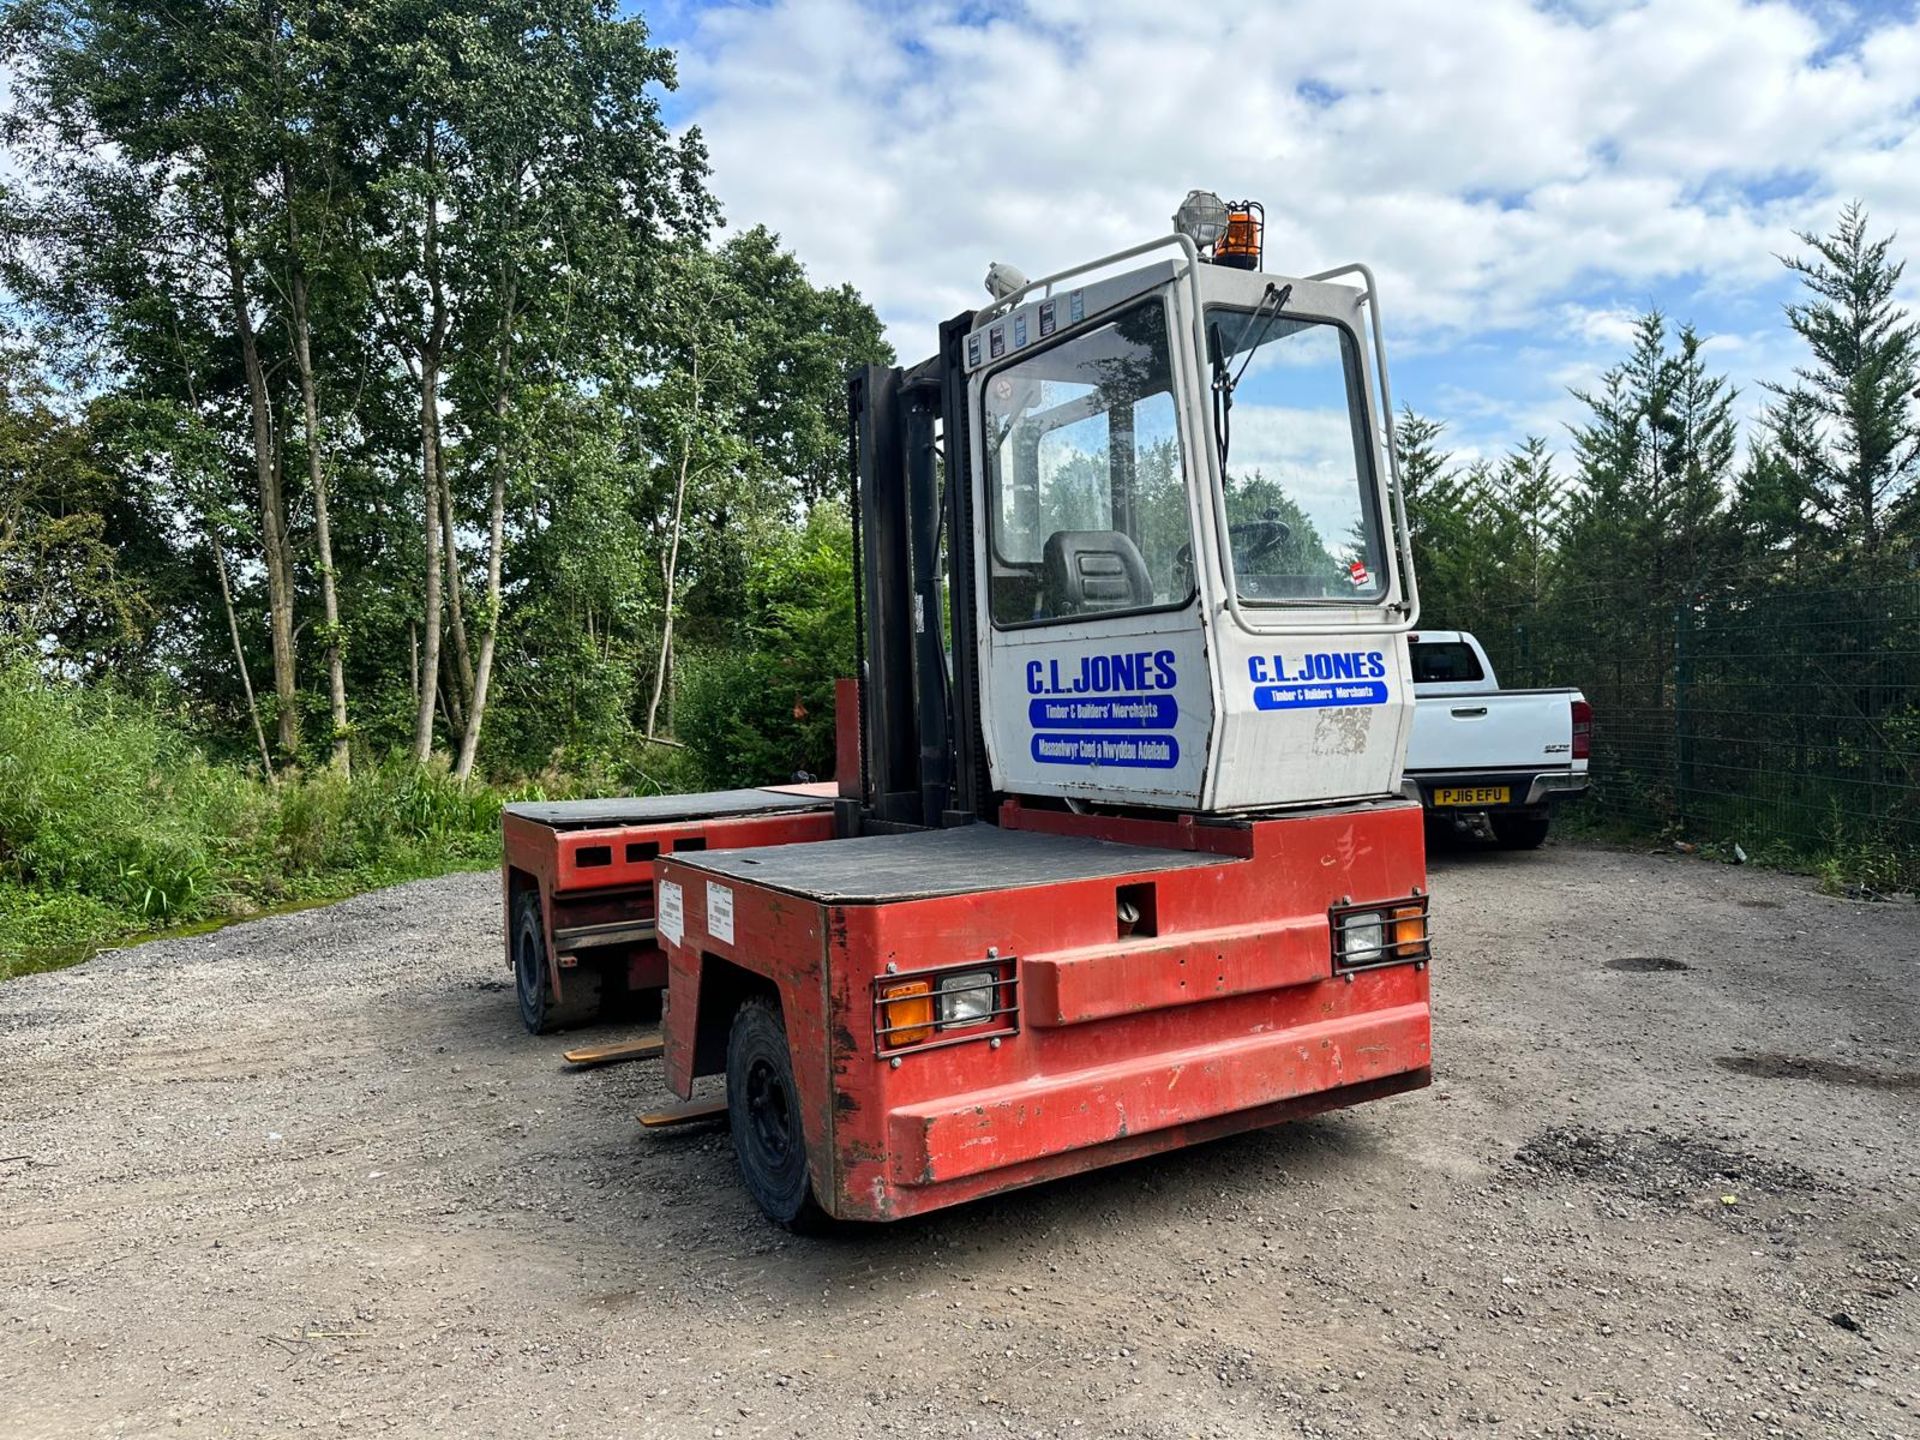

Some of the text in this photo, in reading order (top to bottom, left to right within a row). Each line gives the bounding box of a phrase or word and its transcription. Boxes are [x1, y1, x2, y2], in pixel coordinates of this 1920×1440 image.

[1026, 650, 1177, 694] C.L.JONES
[1248, 651, 1386, 683] C.L.JONES
[1272, 691, 1296, 701] Timber
[1336, 687, 1373, 698] Merchants
[1045, 704, 1069, 719] Timber
[1112, 702, 1158, 718] Merchants
[1080, 740, 1096, 758] Coed
[1097, 743, 1102, 758] a
[1443, 789, 1502, 803] PJ16 EFU
